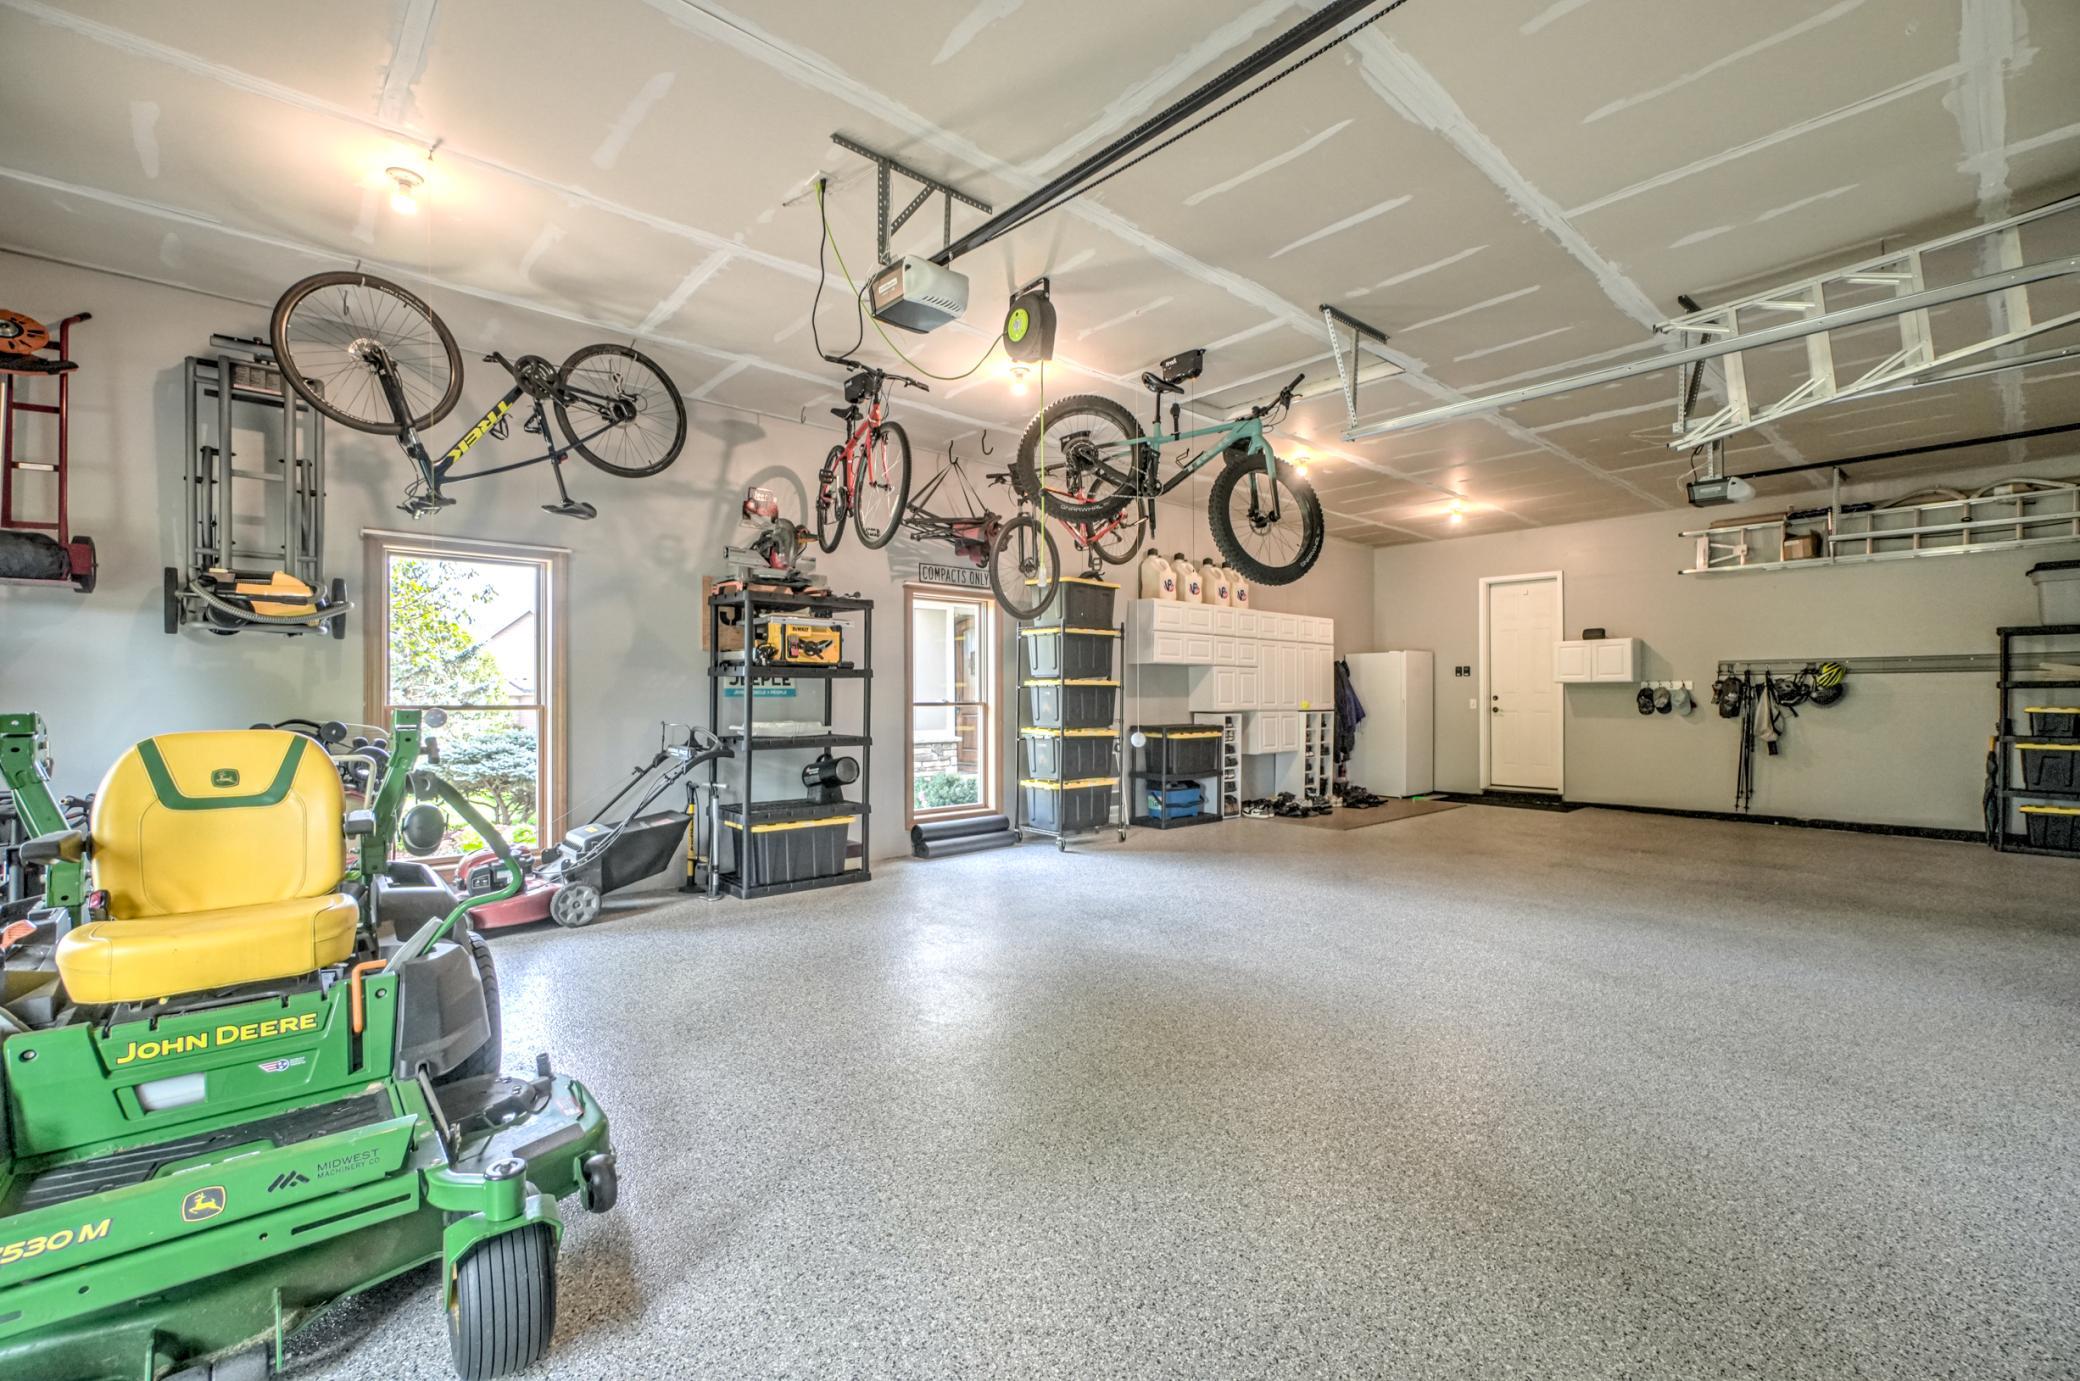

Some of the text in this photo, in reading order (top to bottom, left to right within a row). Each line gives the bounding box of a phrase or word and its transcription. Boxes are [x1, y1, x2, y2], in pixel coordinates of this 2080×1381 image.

[447, 401, 513, 462] TREK
[922, 566, 989, 585] COMPACTS ONLY
[729, 676, 791, 686] JEPLE
[116, 1012, 318, 1065] JOHN DEERE
[317, 1149, 379, 1171] MIDWEST
[317, 1162, 365, 1178] MACHINERY
[0, 1218, 113, 1265] 530 M
